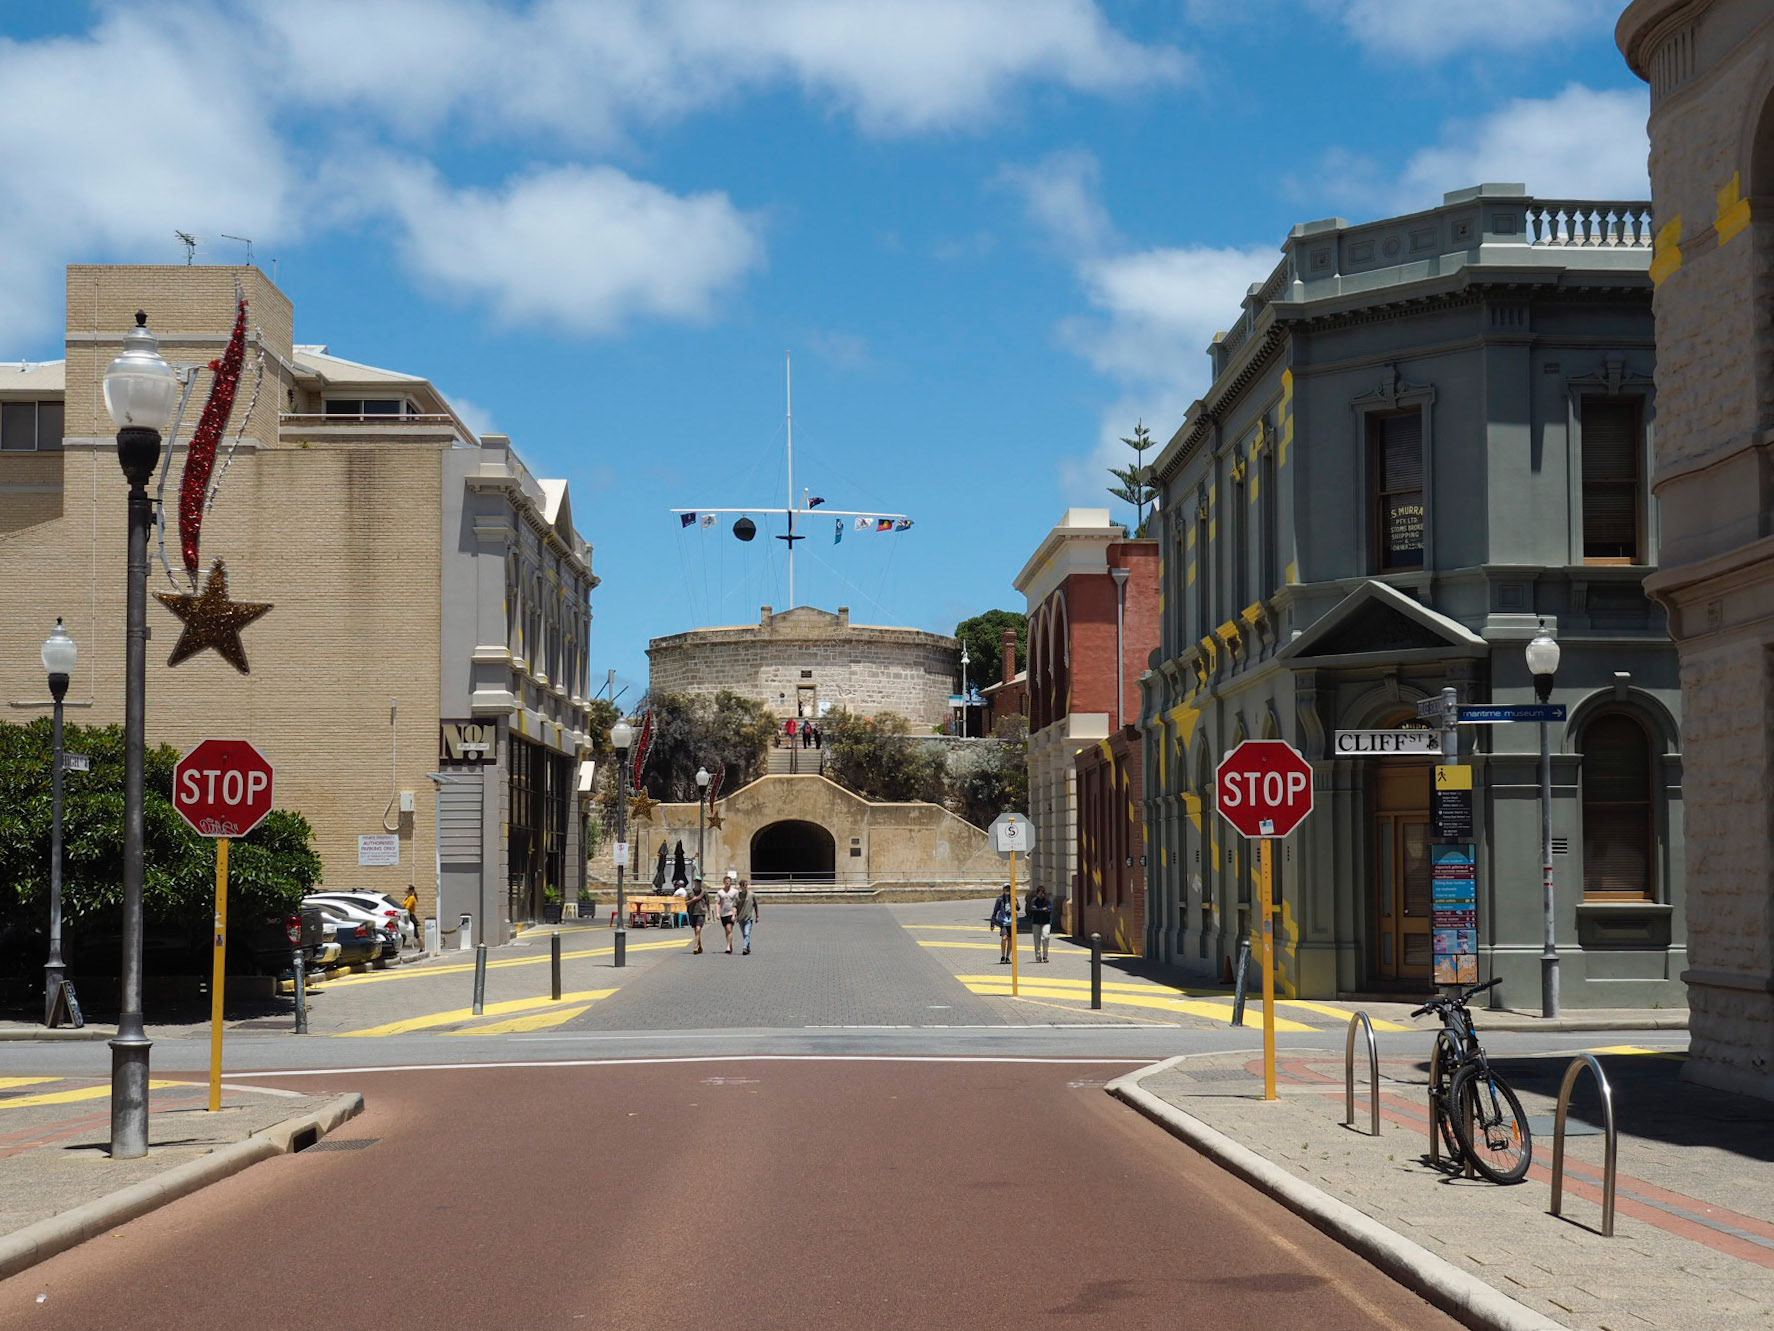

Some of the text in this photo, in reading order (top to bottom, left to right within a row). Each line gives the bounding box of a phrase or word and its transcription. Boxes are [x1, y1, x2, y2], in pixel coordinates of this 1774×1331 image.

[1391, 532, 1419, 540] SHIPPING
[1463, 709, 1544, 718] maritime museum
[1338, 733, 1424, 752] CLIFF ST
[180, 768, 268, 806] STOP
[1223, 770, 1307, 807] STOP
